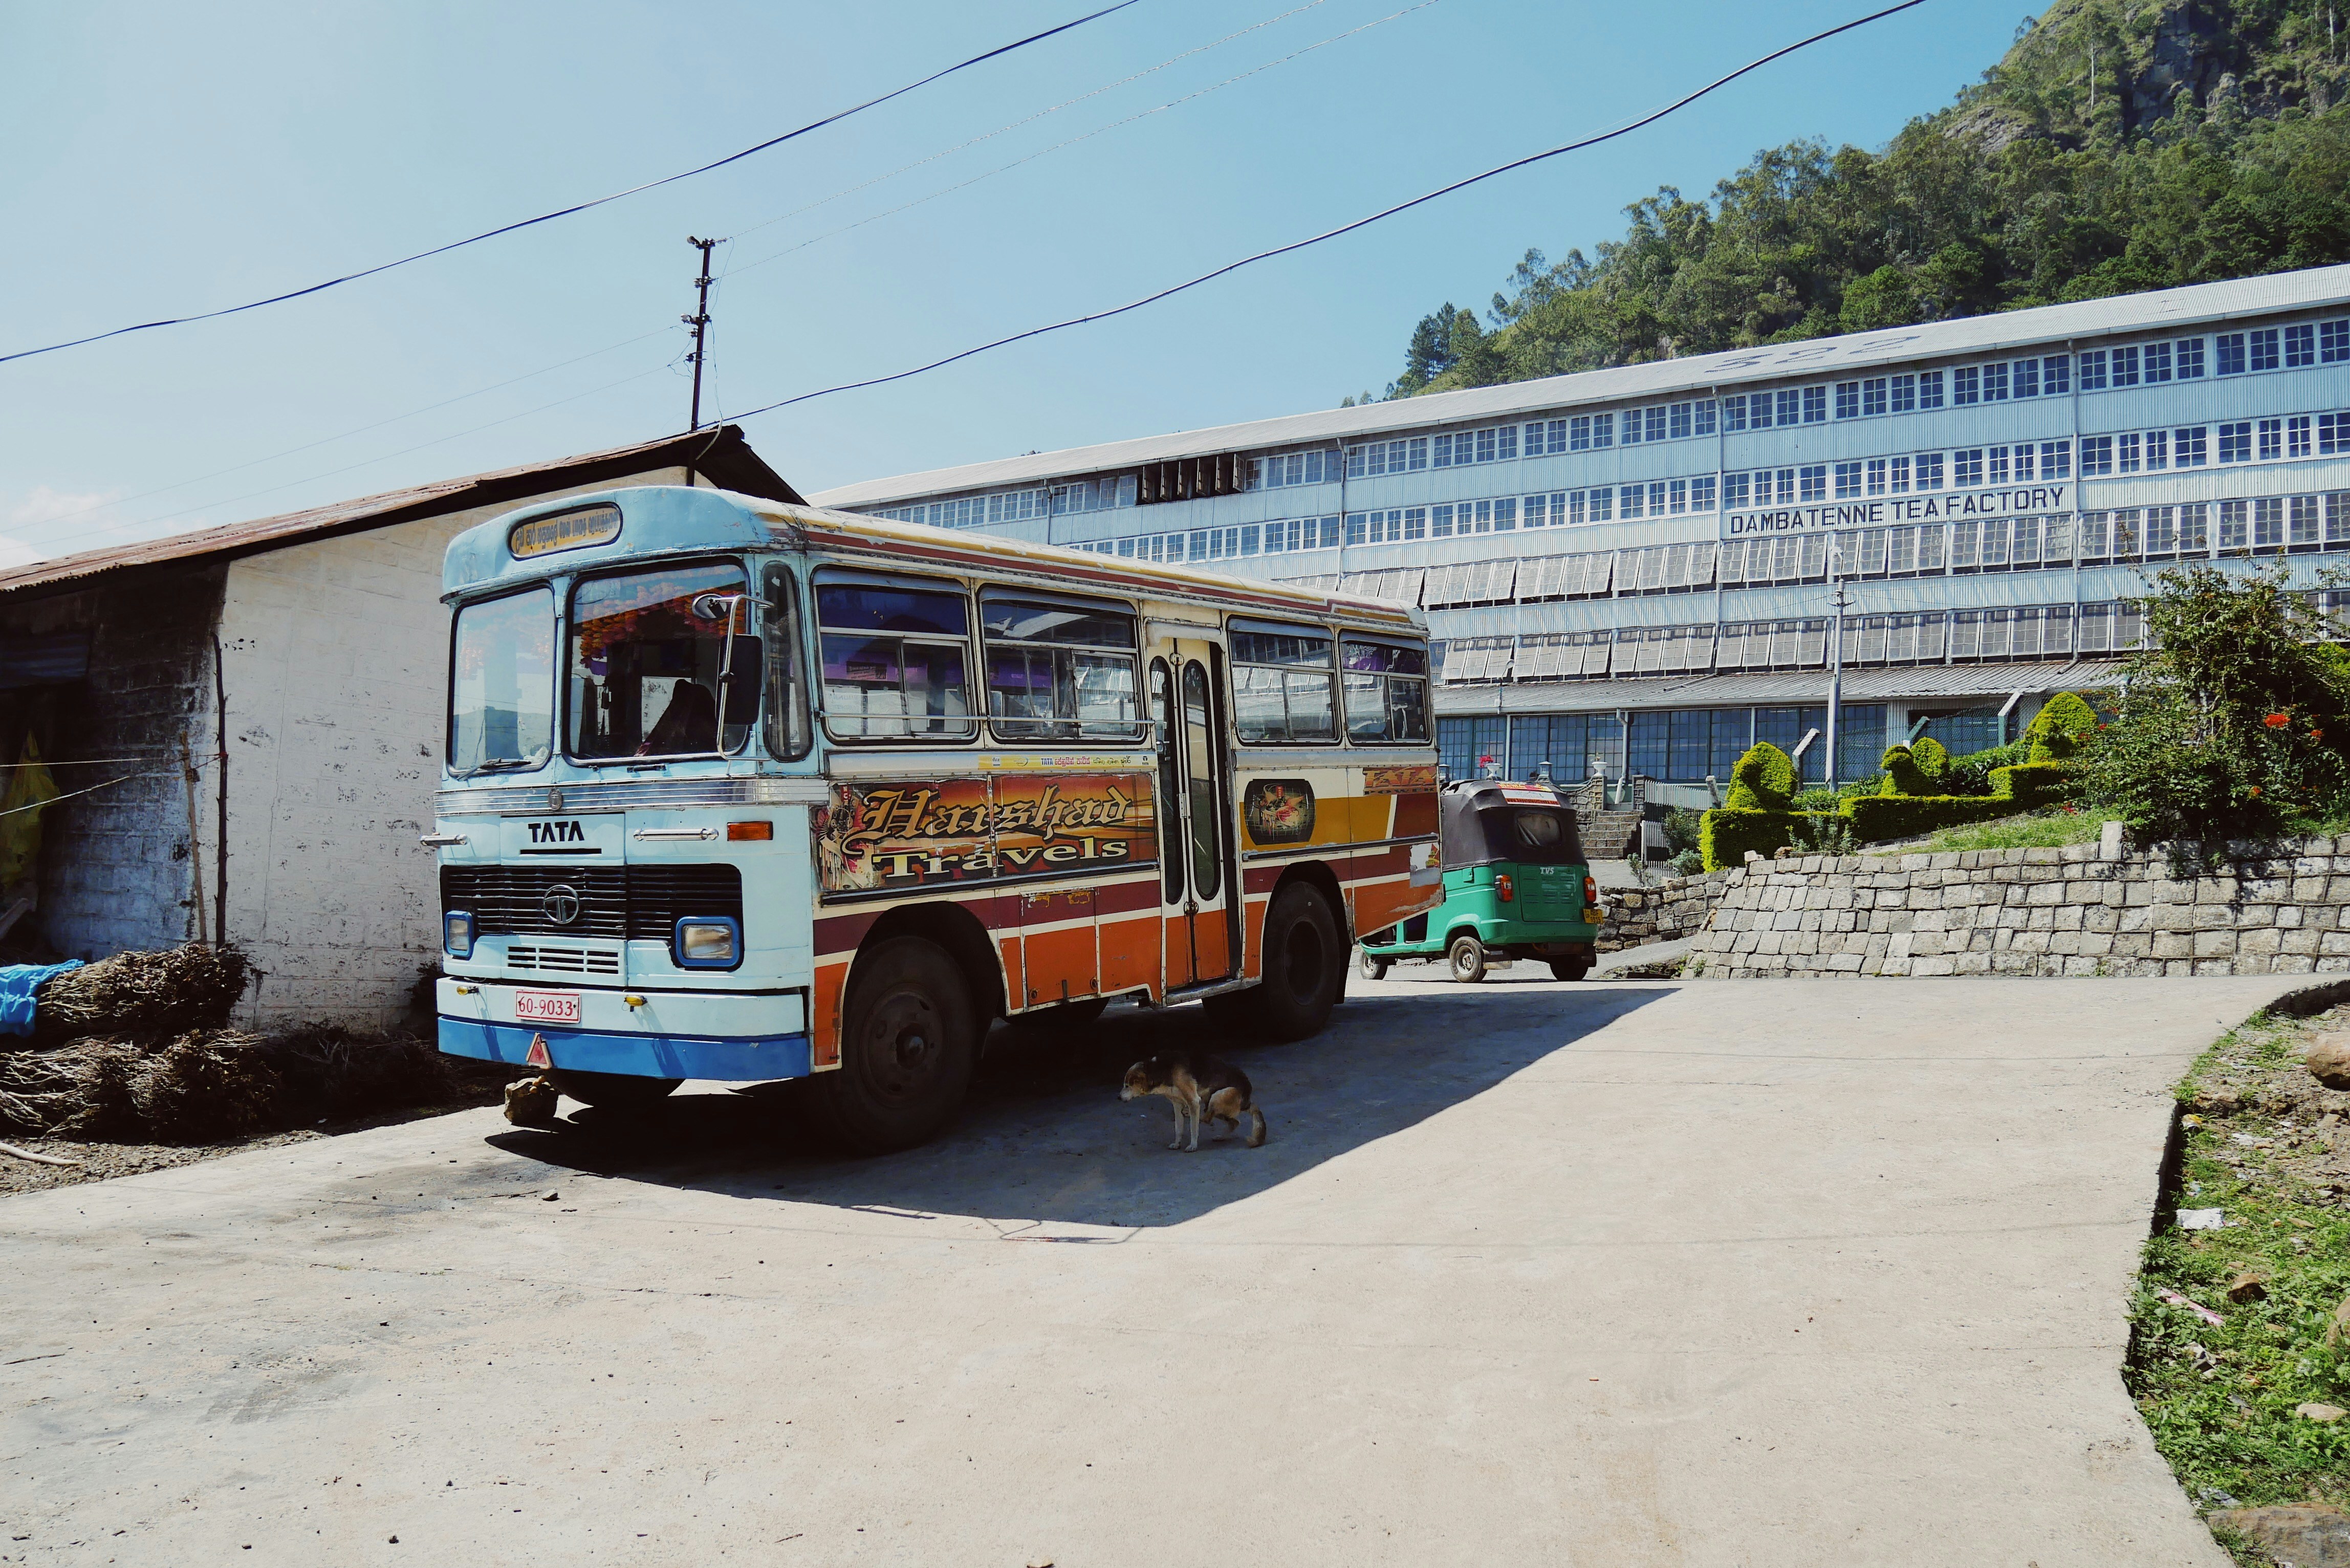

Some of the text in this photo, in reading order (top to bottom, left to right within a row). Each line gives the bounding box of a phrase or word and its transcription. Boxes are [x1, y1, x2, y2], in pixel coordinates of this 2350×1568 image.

[1731, 487, 2064, 534] DAMBATENNE TEA FACTORY
[1363, 769, 1434, 787] TATA
[528, 820, 584, 843] TATA
[841, 785, 1134, 857] Harshad
[872, 837, 1129, 878] Travels
[517, 995, 574, 1017] 60-9033
